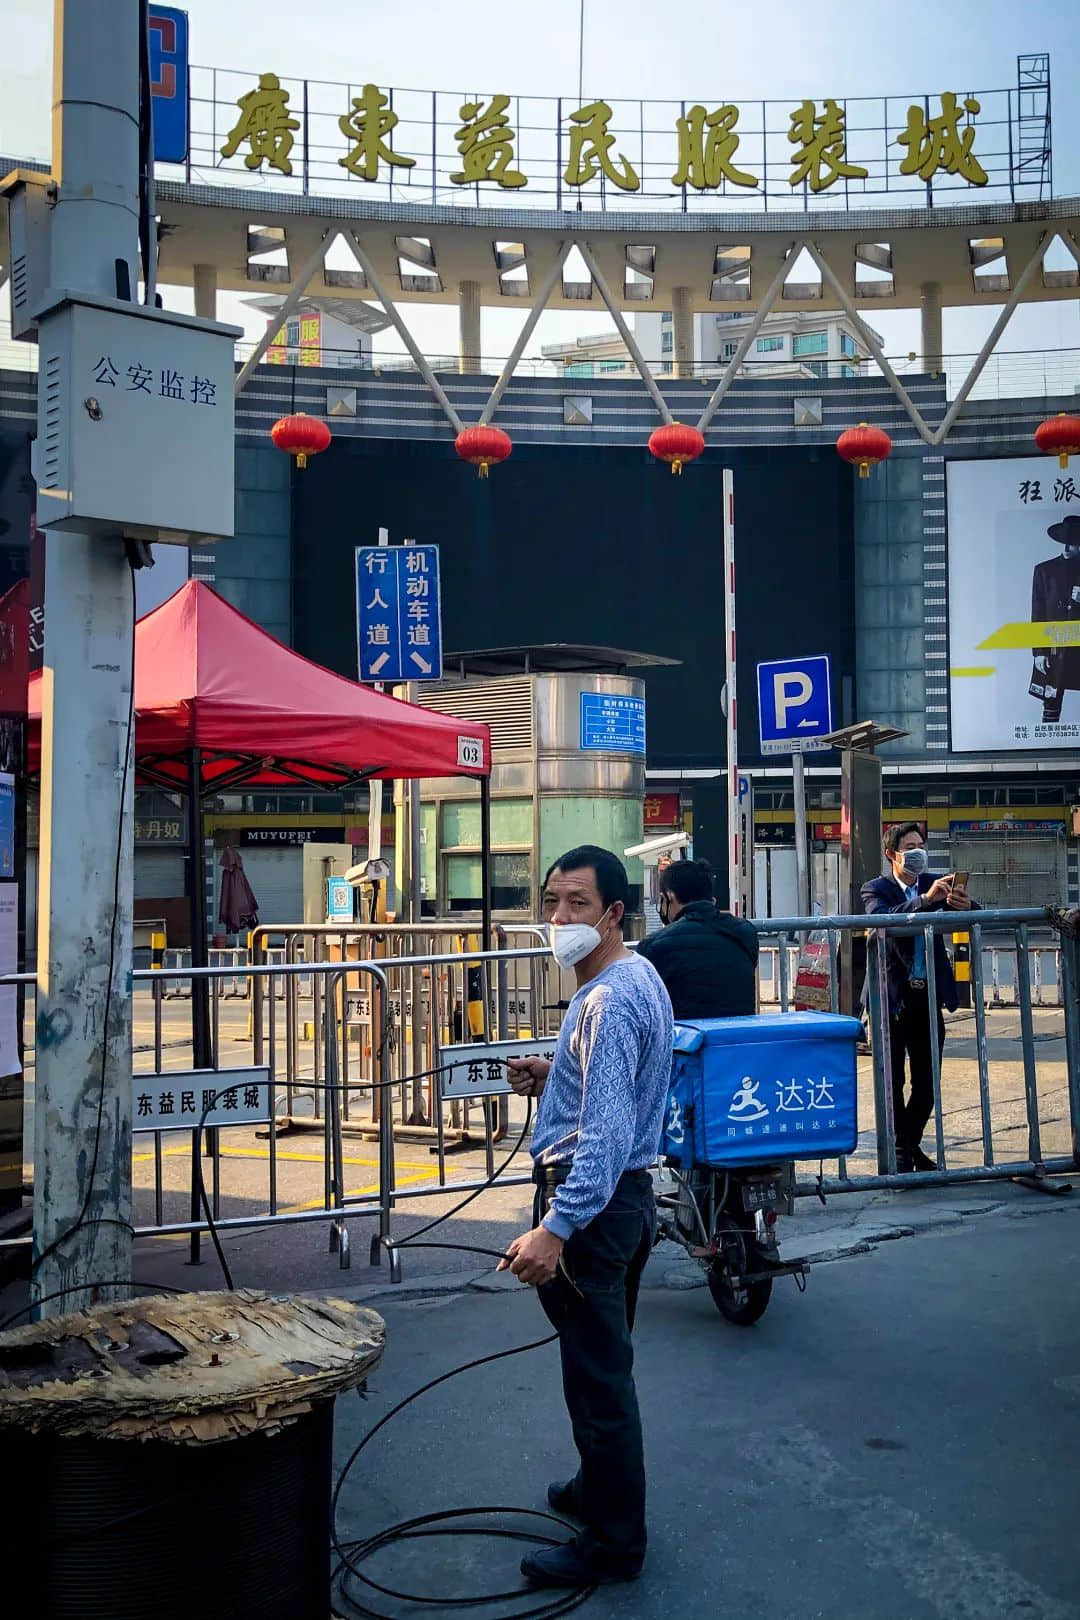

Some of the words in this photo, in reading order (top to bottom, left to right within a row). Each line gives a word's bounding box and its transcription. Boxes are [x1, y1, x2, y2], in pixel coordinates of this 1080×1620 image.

[92, 356, 217, 406] 公安监控
[365, 552, 391, 646] 行人道
[405, 551, 431, 646] 机动车道
[773, 671, 813, 730] P
[463, 746, 478, 763] 03
[247, 831, 311, 841] MUYUFEI
[775, 1076, 836, 1113] 达达
